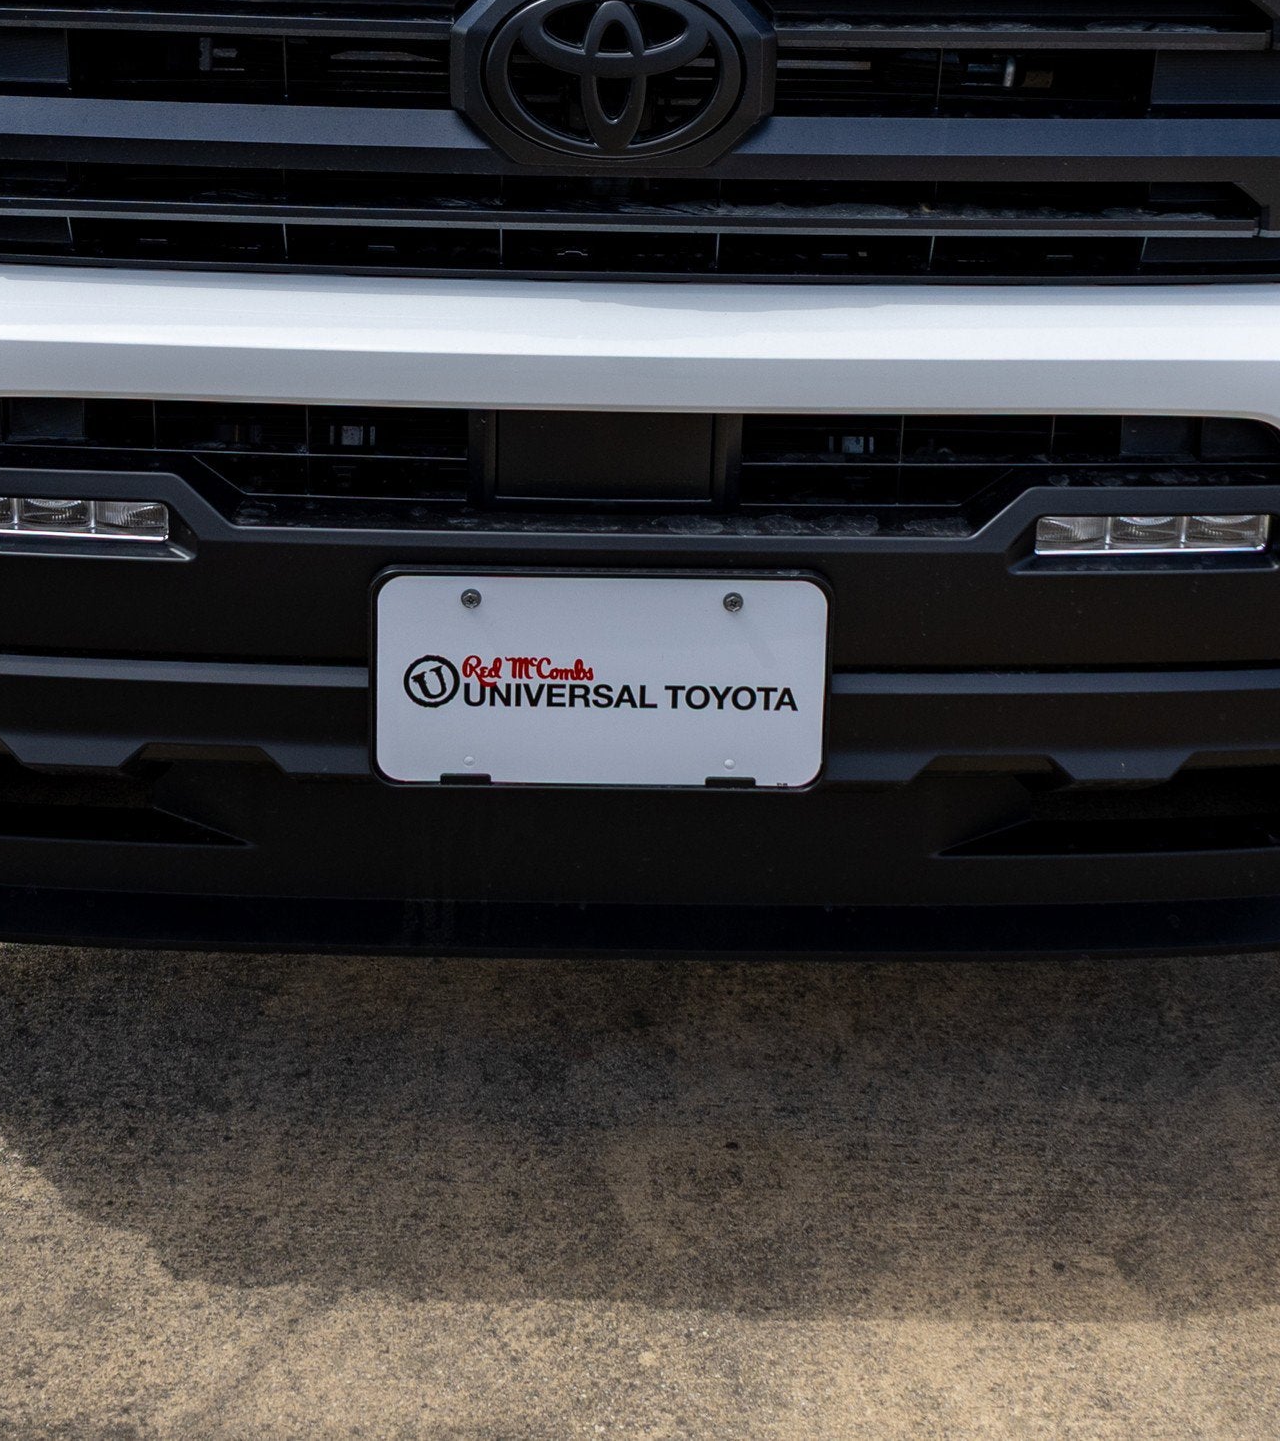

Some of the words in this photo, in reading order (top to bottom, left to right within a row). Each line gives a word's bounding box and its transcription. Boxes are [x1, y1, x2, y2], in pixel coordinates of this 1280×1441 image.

[462, 655, 502, 687] Red
[505, 656, 594, 681] McCombs
[463, 682, 657, 709] UNIVERSAL
[664, 684, 799, 712] TOYOTA
